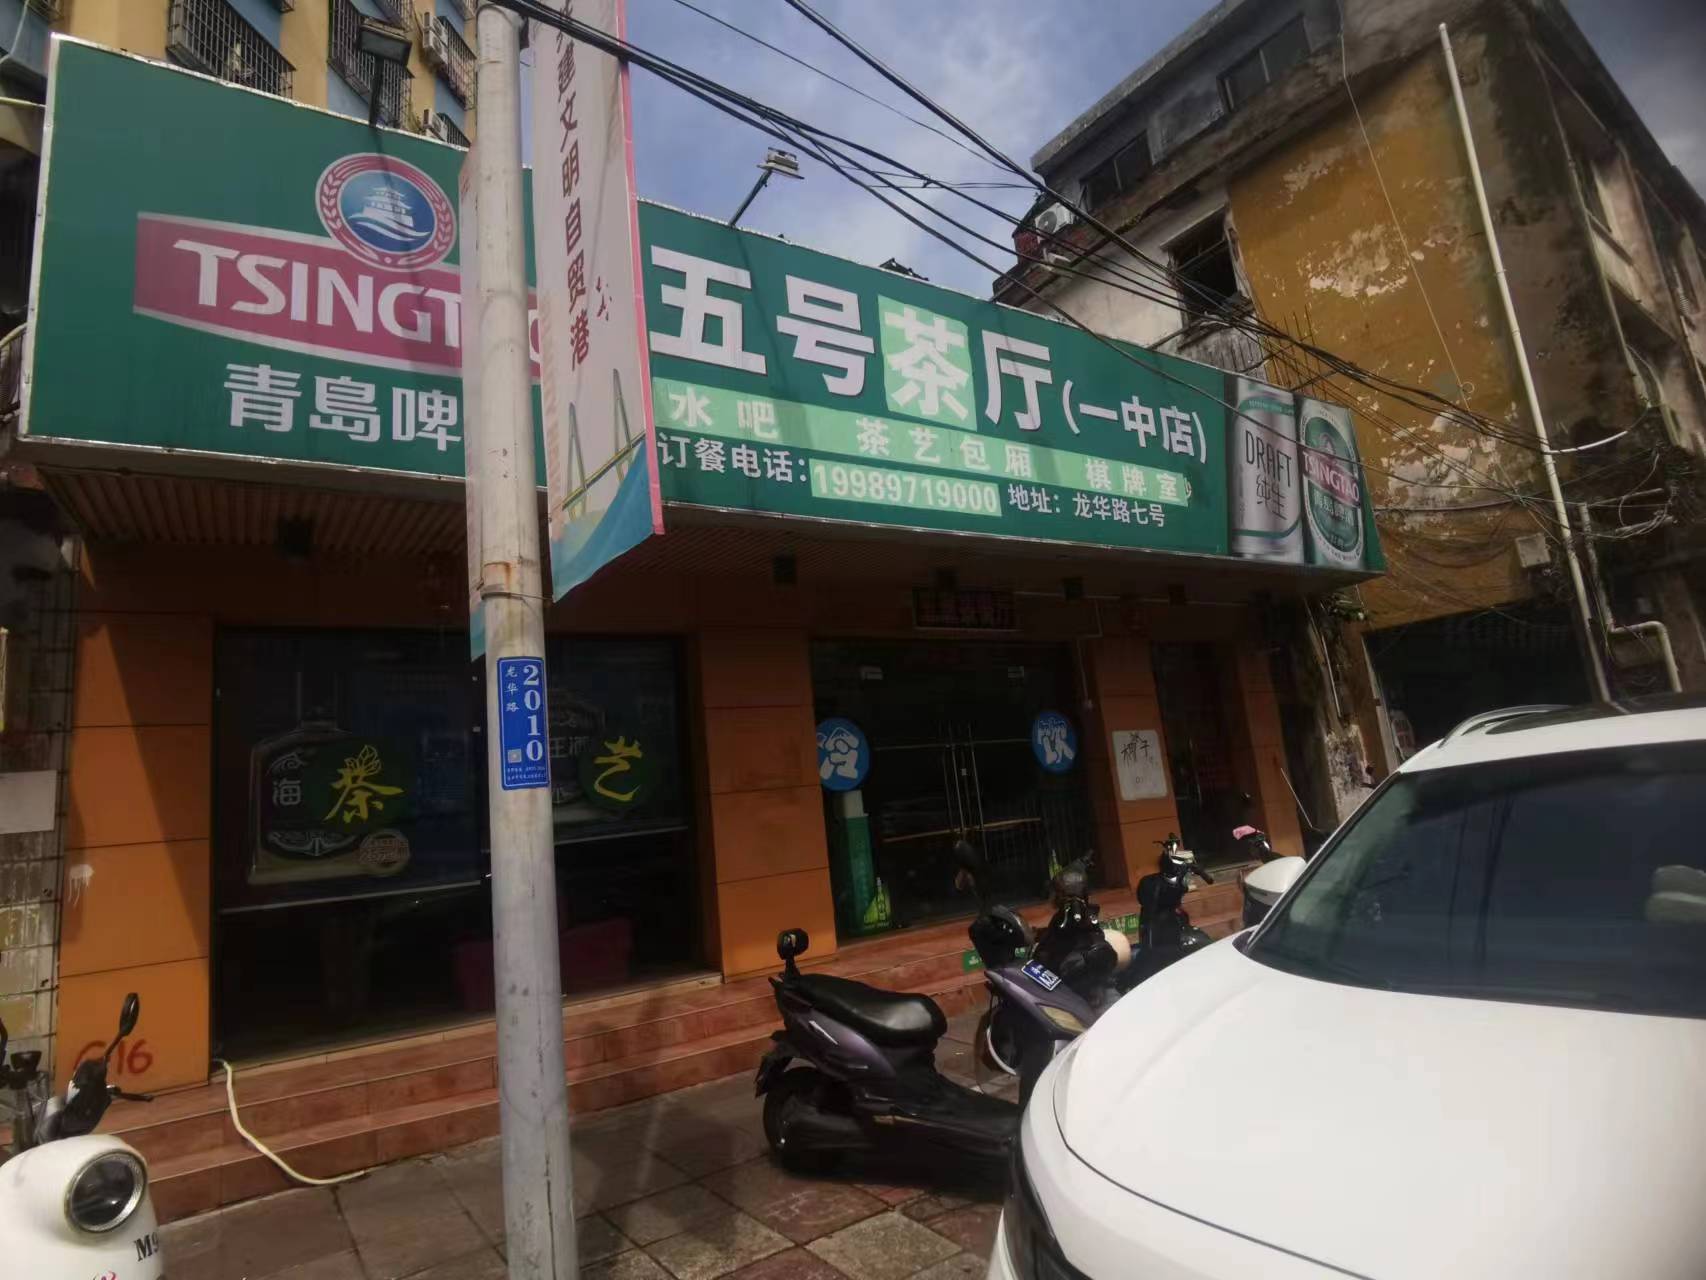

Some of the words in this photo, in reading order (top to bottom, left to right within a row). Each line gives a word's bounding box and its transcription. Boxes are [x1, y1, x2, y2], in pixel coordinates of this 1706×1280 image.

[173, 240, 541, 362] TSINGT
[668, 387, 780, 439] 水吧
[855, 417, 1031, 478] 茶艺包厢
[1245, 429, 1292, 487] DRAFT
[814, 464, 997, 512] 19989719000
[1302, 450, 1360, 502] TSINGTAO
[523, 664, 543, 762] 2010
[593, 735, 644, 802] 艺
